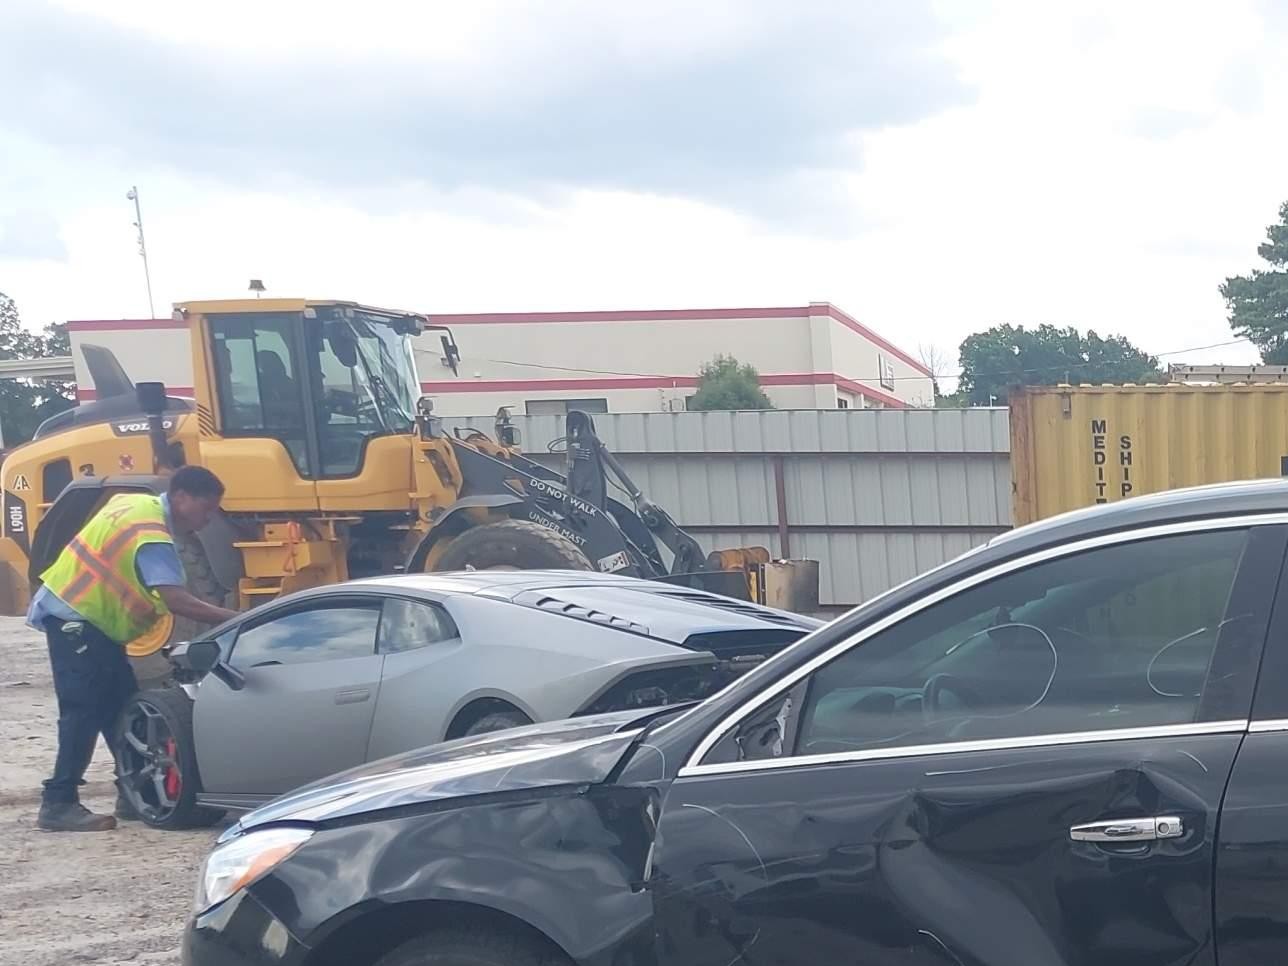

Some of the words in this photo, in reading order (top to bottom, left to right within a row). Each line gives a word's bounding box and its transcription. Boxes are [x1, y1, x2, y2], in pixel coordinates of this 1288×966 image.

[118, 421, 173, 433] VOLO
[1120, 435, 1133, 497] SHIP
[530, 479, 545, 491] DO
[546, 486, 568, 502] NOT
[569, 496, 598, 517] WALK
[9, 506, 24, 532] L90H
[528, 511, 560, 533] UNDER
[561, 528, 587, 547] MAST
